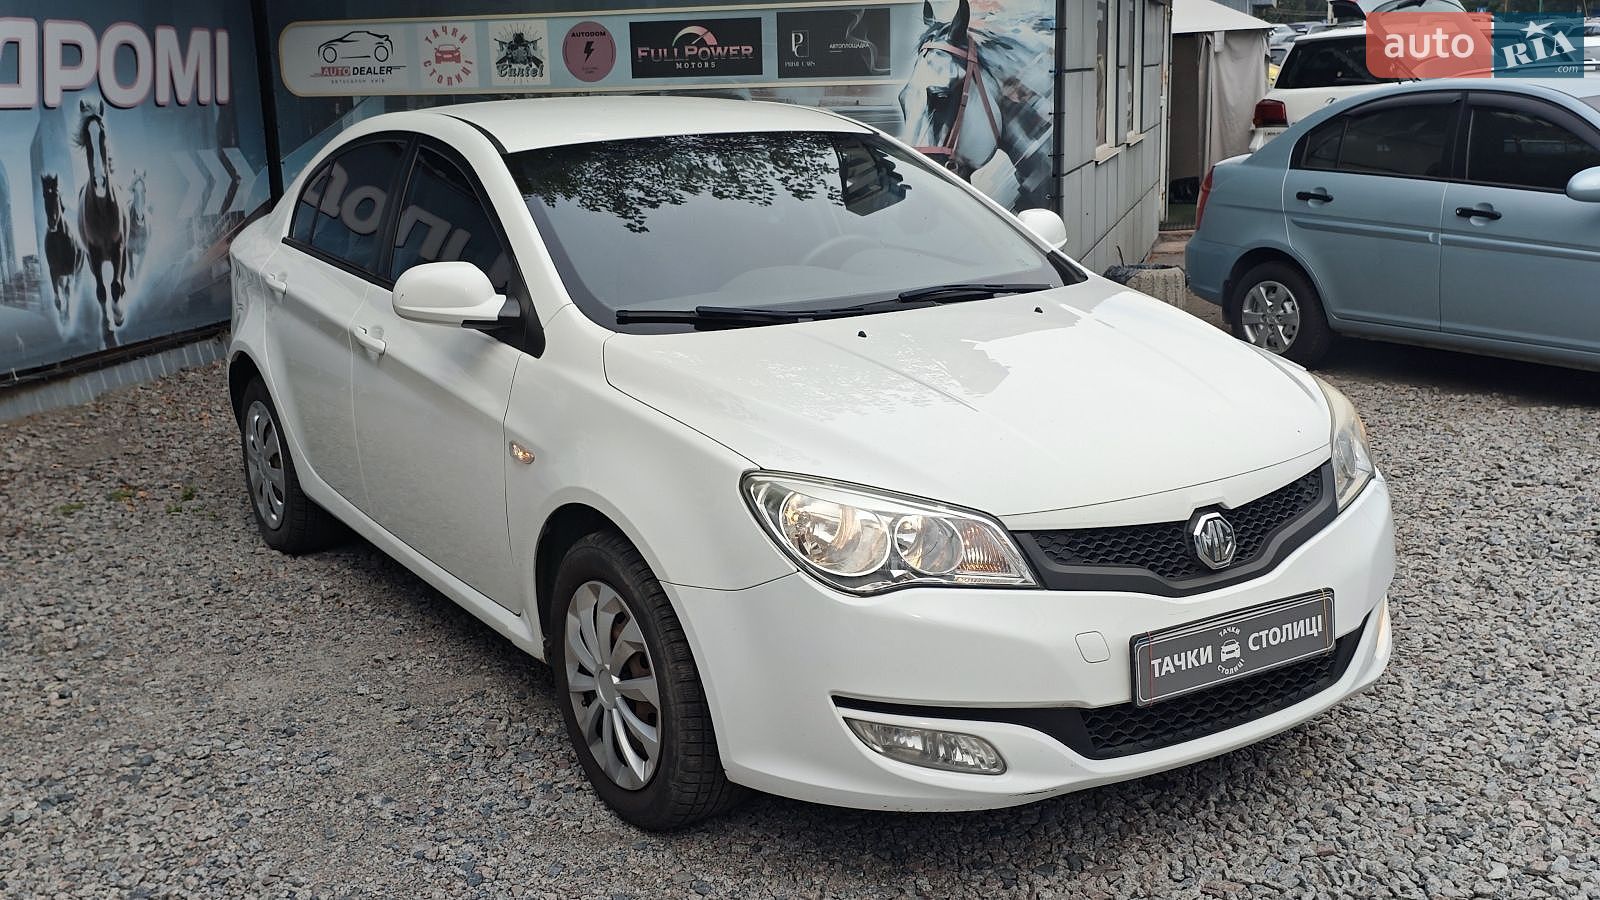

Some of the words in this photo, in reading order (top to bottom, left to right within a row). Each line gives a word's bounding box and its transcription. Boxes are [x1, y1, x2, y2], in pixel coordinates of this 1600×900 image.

[321, 67, 350, 76] AUTO
[352, 66, 393, 76] DEALER
[675, 61, 717, 69] MOTORS
[1201, 519, 1232, 562] MG
[1218, 626, 1241, 638] ТАЧКИ
[1150, 645, 1213, 678] ТАЧКИ
[1248, 614, 1323, 651] СТОЛИЦІ
